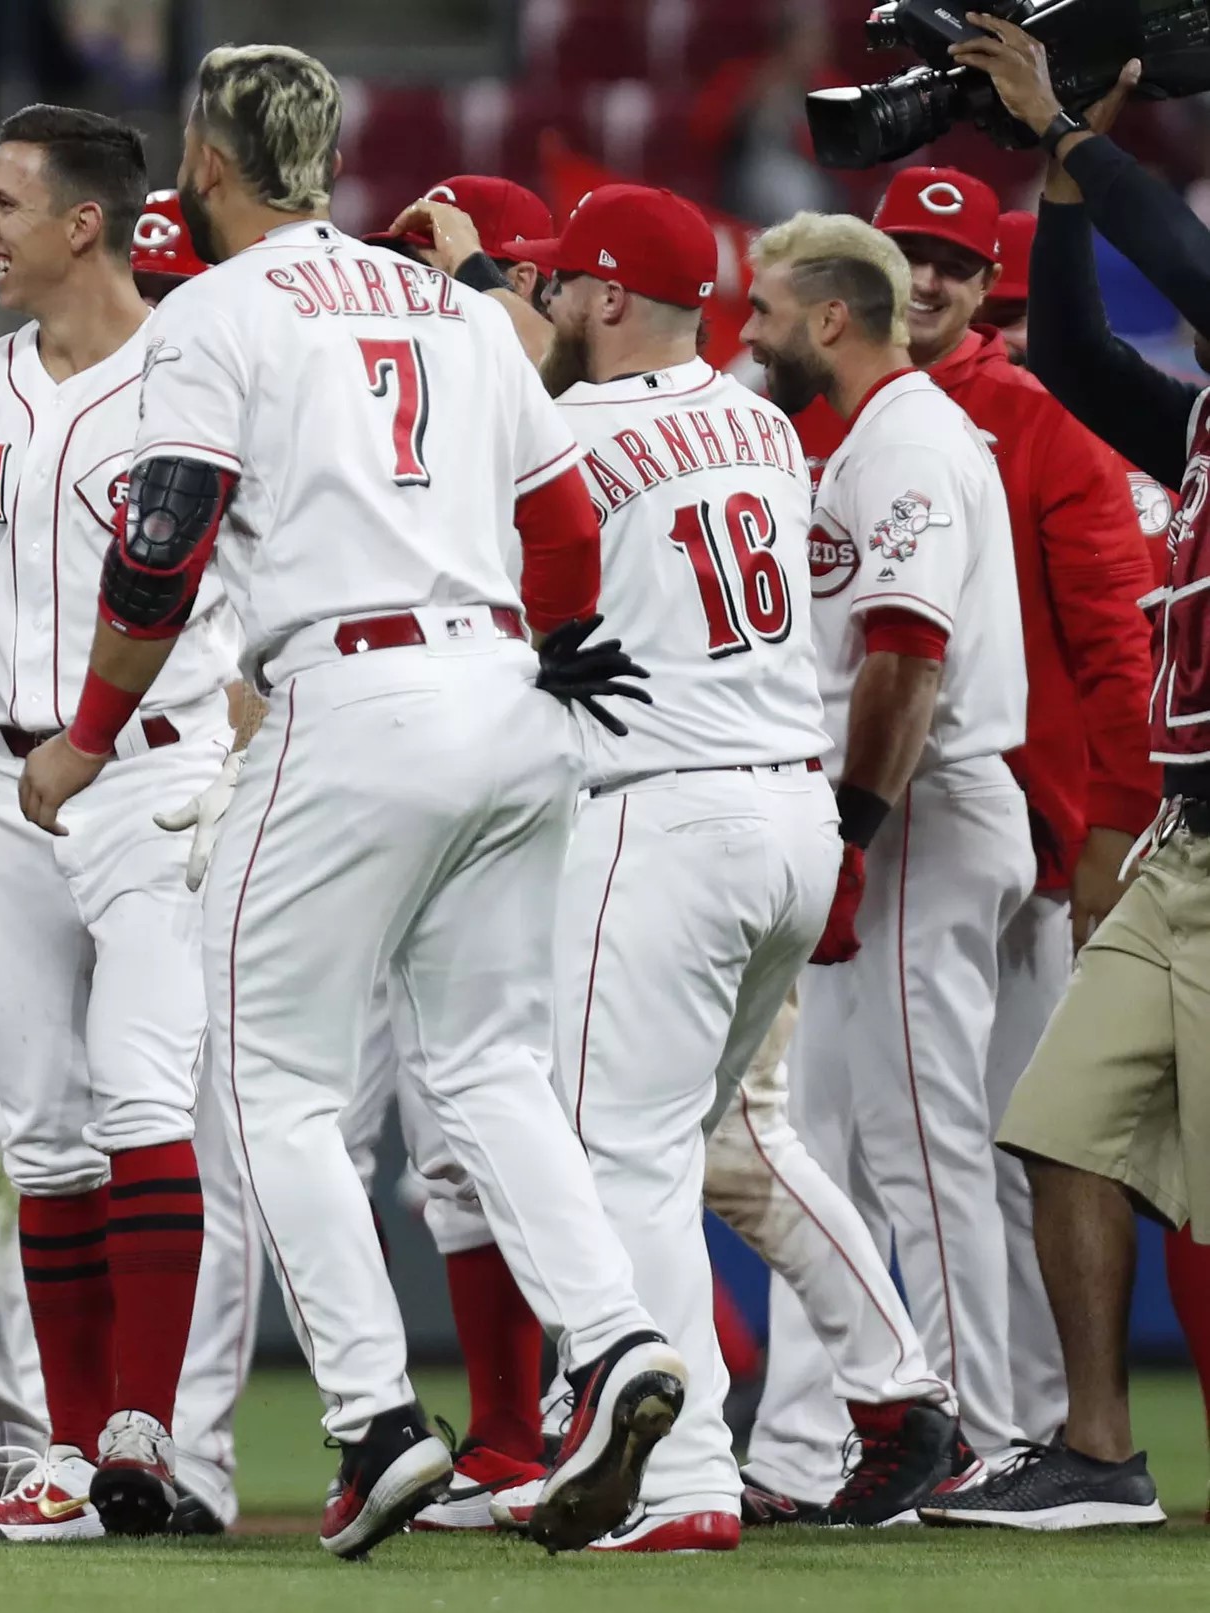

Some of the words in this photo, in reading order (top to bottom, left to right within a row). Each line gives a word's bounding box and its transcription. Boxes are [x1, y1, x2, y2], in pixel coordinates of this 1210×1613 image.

[355, 336, 431, 489] 7
[583, 407, 797, 530] ARNHART
[666, 491, 793, 661] 16
[808, 540, 855, 564] EDS
